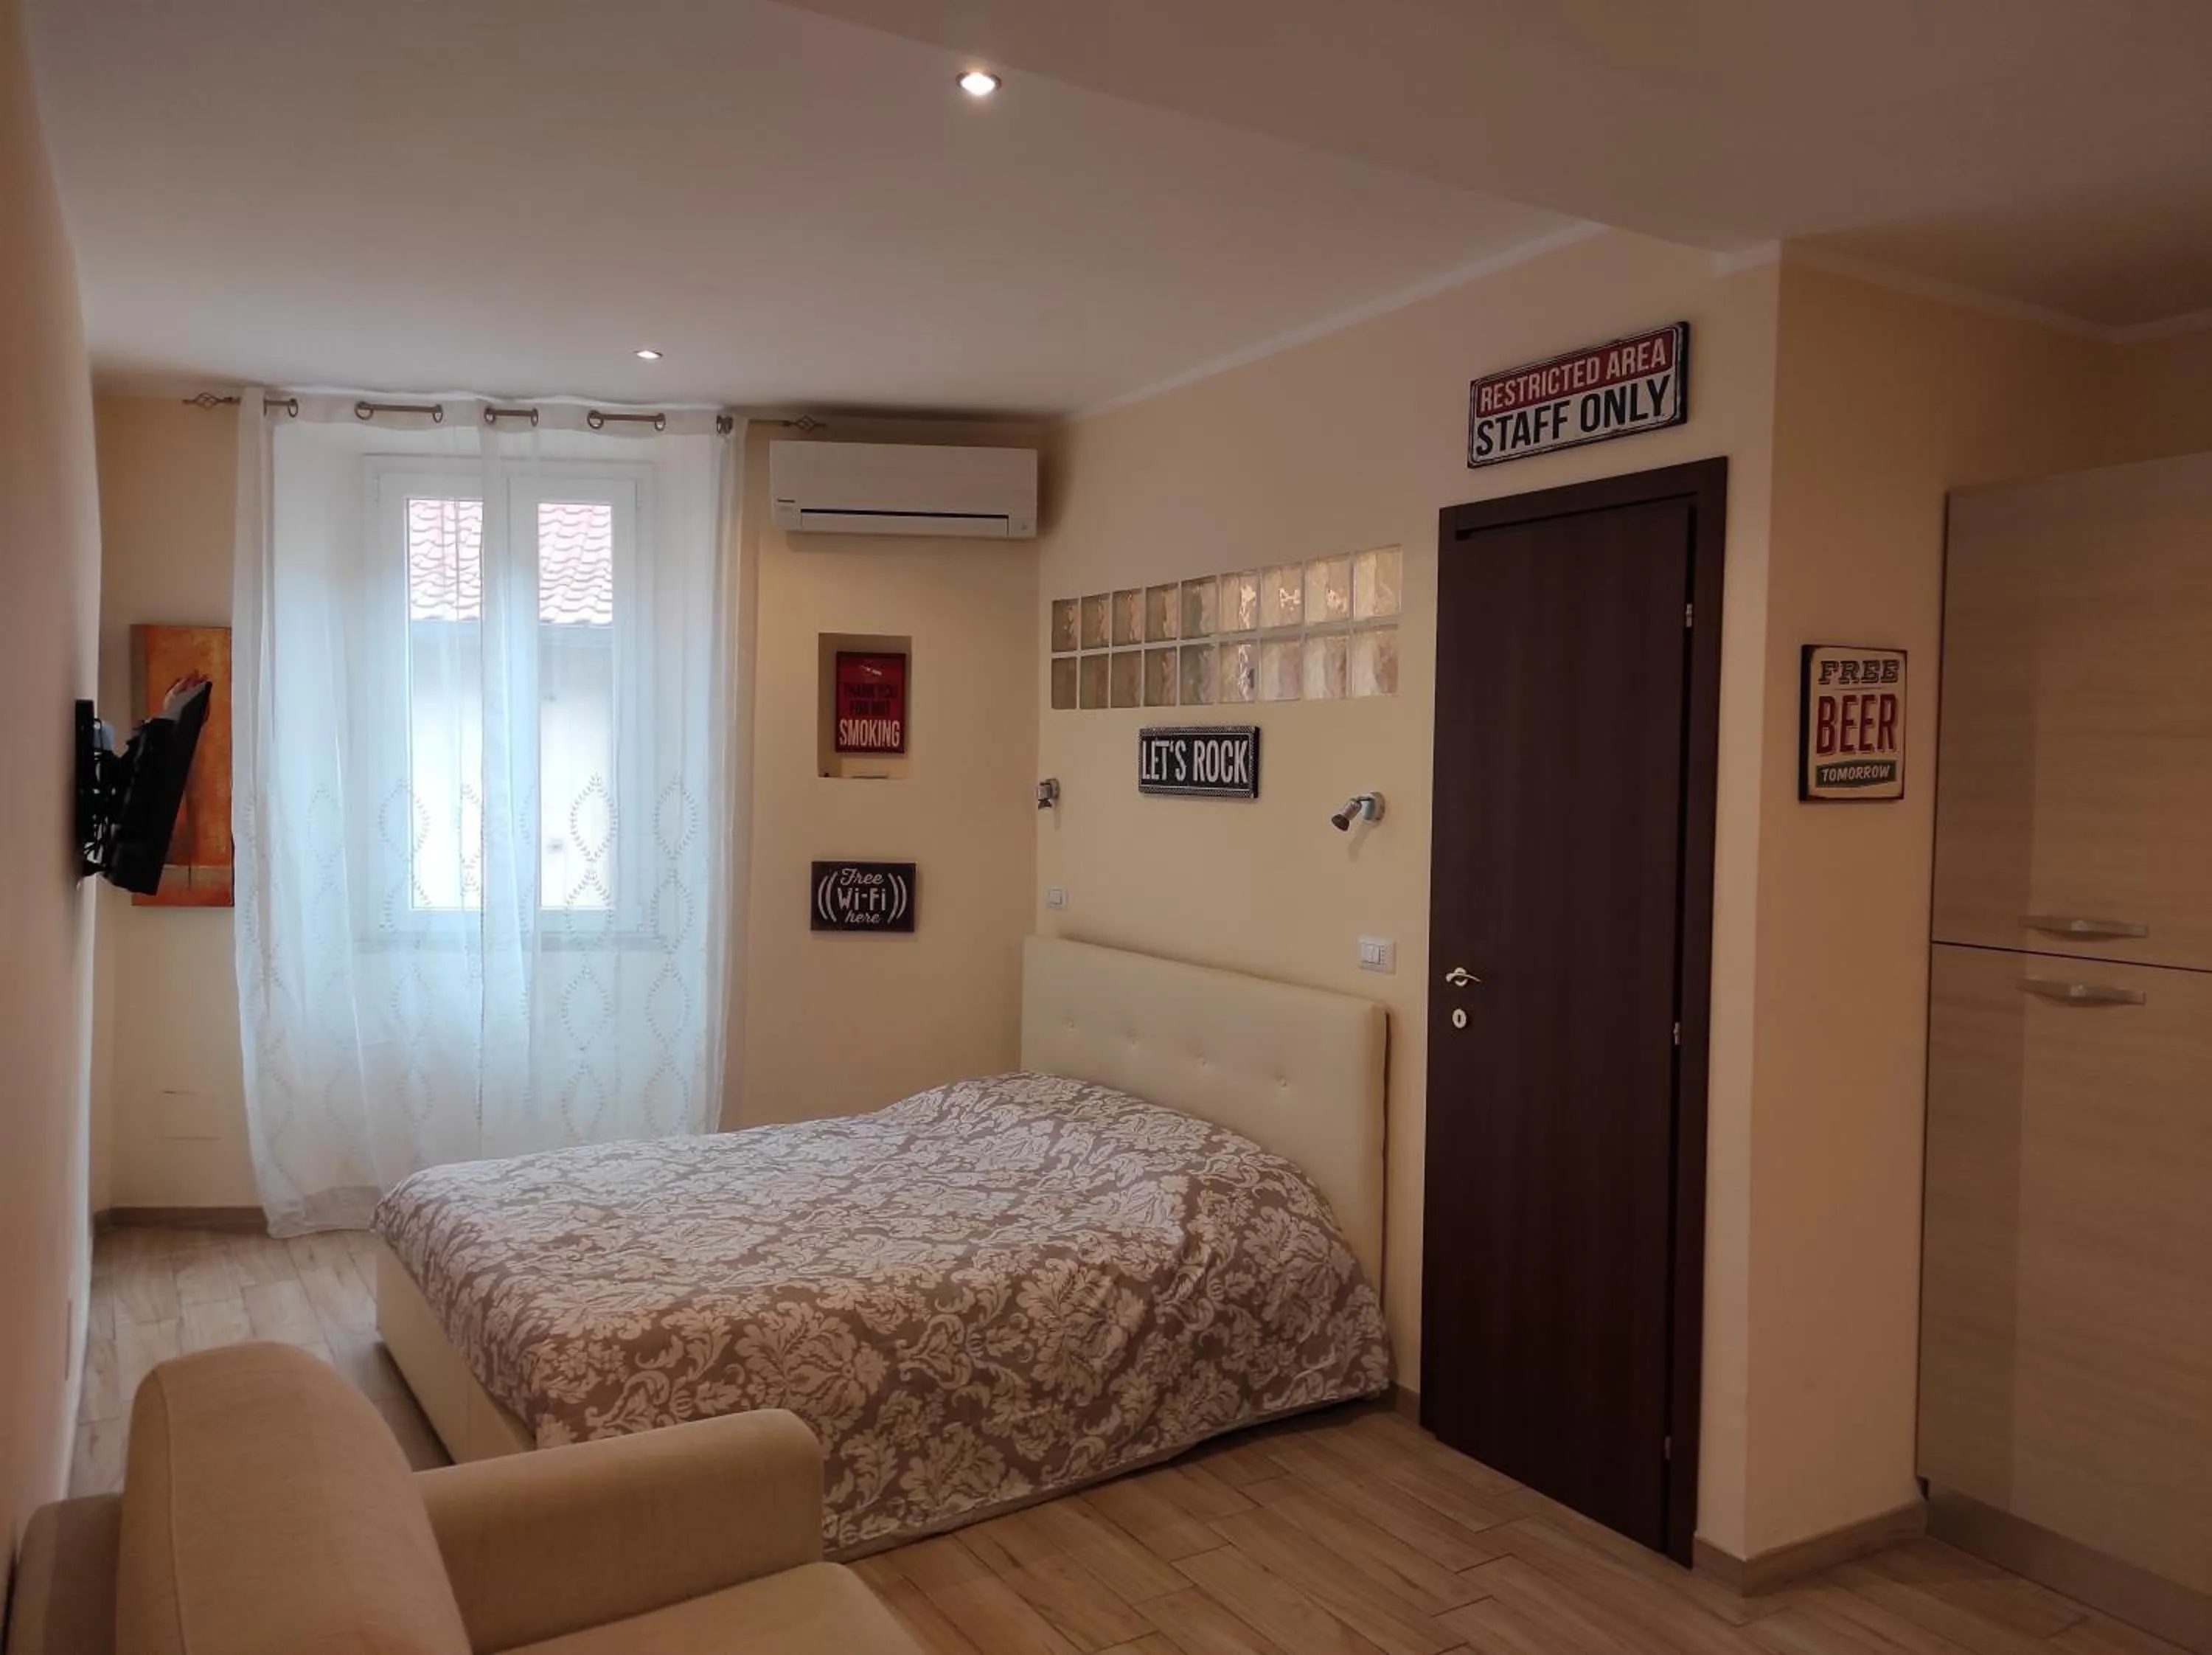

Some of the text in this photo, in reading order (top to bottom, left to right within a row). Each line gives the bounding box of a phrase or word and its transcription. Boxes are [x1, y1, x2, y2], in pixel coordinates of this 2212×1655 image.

[1480, 338, 1666, 412] RESTRICTED AREA
[1476, 375, 1671, 456] STAFF ONLY
[1818, 659, 1900, 684] FREE
[840, 719, 900, 747] SMOKING
[1816, 693, 1899, 754] BEER
[1142, 740, 1248, 783] LET'S ROCK
[1822, 764, 1891, 783] TOMORROW
[840, 868, 884, 886] Free
[837, 887, 886, 911] Wi-Fi
[845, 909, 880, 923] here
